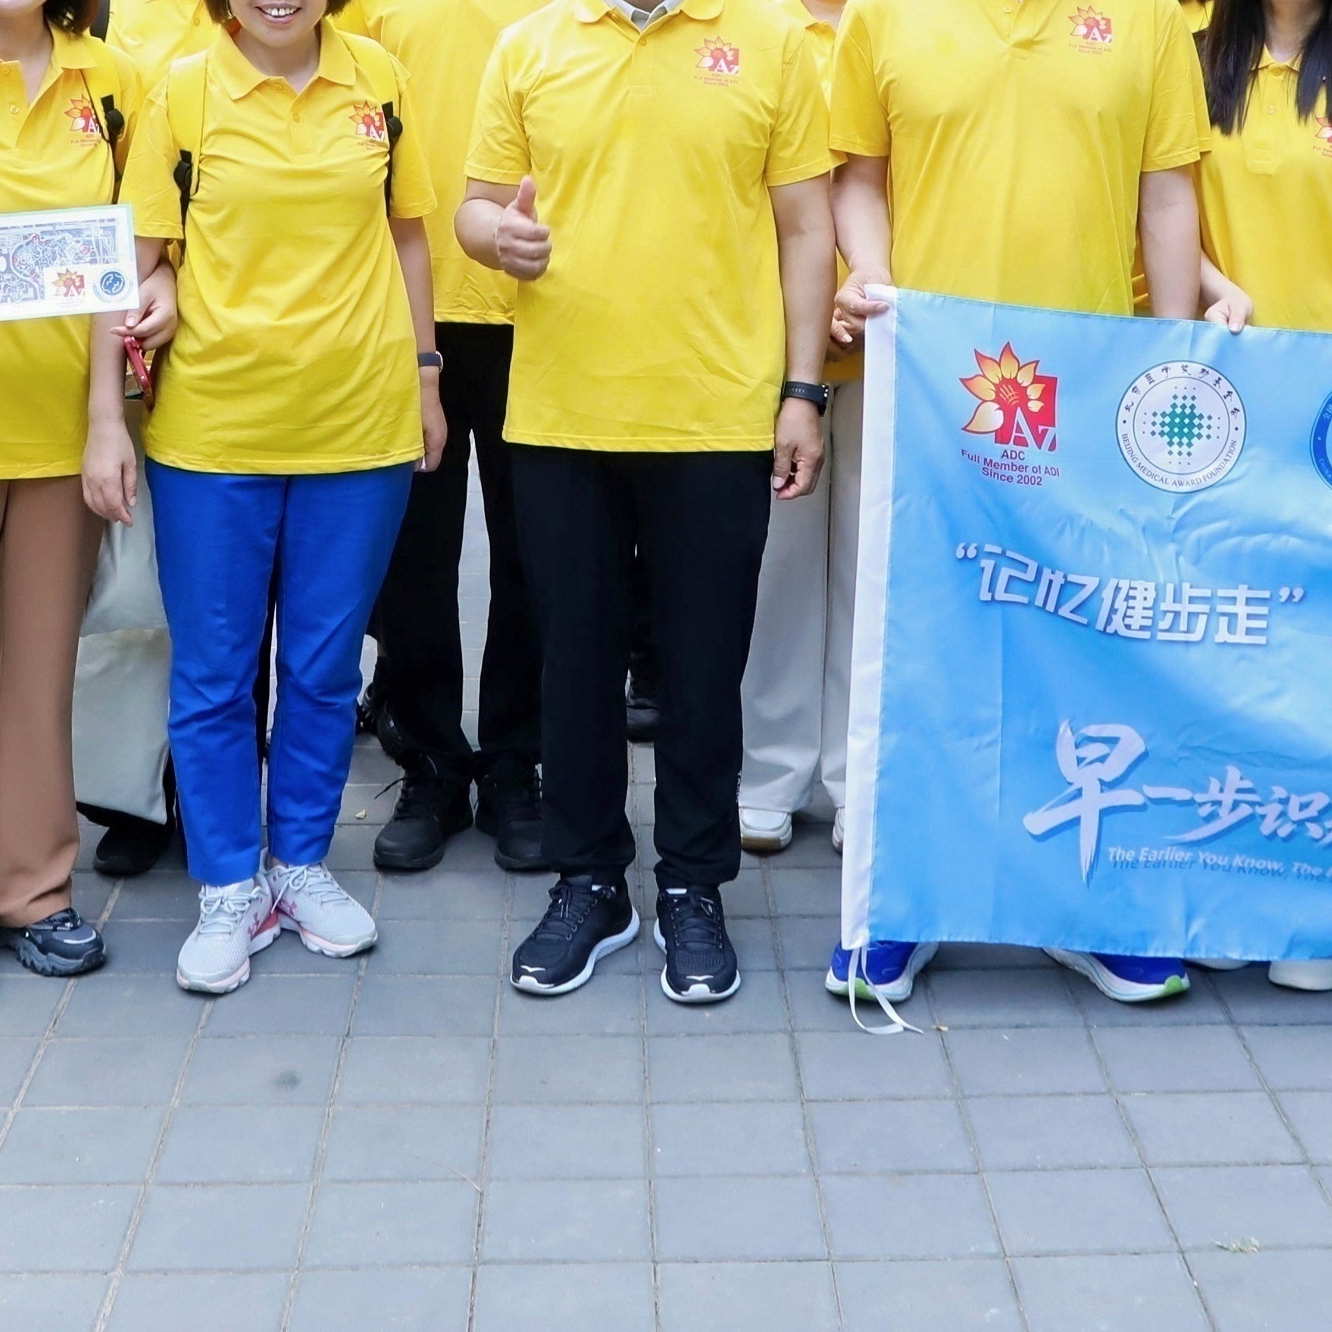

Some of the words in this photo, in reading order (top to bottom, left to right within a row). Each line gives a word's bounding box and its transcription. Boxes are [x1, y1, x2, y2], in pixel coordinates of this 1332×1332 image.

[961, 448, 980, 464] Full
[983, 457, 1029, 473] Member
[1031, 465, 1042, 474] of
[1044, 466, 1060, 477] ADI
[1001, 449, 1026, 461] ADC
[1136, 462, 1170, 486] MEDICAL
[1171, 476, 1203, 488] AWARD
[1203, 439, 1238, 483] FOUNDATION
[981, 466, 1014, 483] Since
[1016, 474, 1043, 486] 2002
[1108, 846, 1135, 863] The
[1138, 846, 1193, 863] Earlier
[1198, 851, 1229, 866] You
[1232, 854, 1285, 872] Know,
[1292, 861, 1323, 876] The
